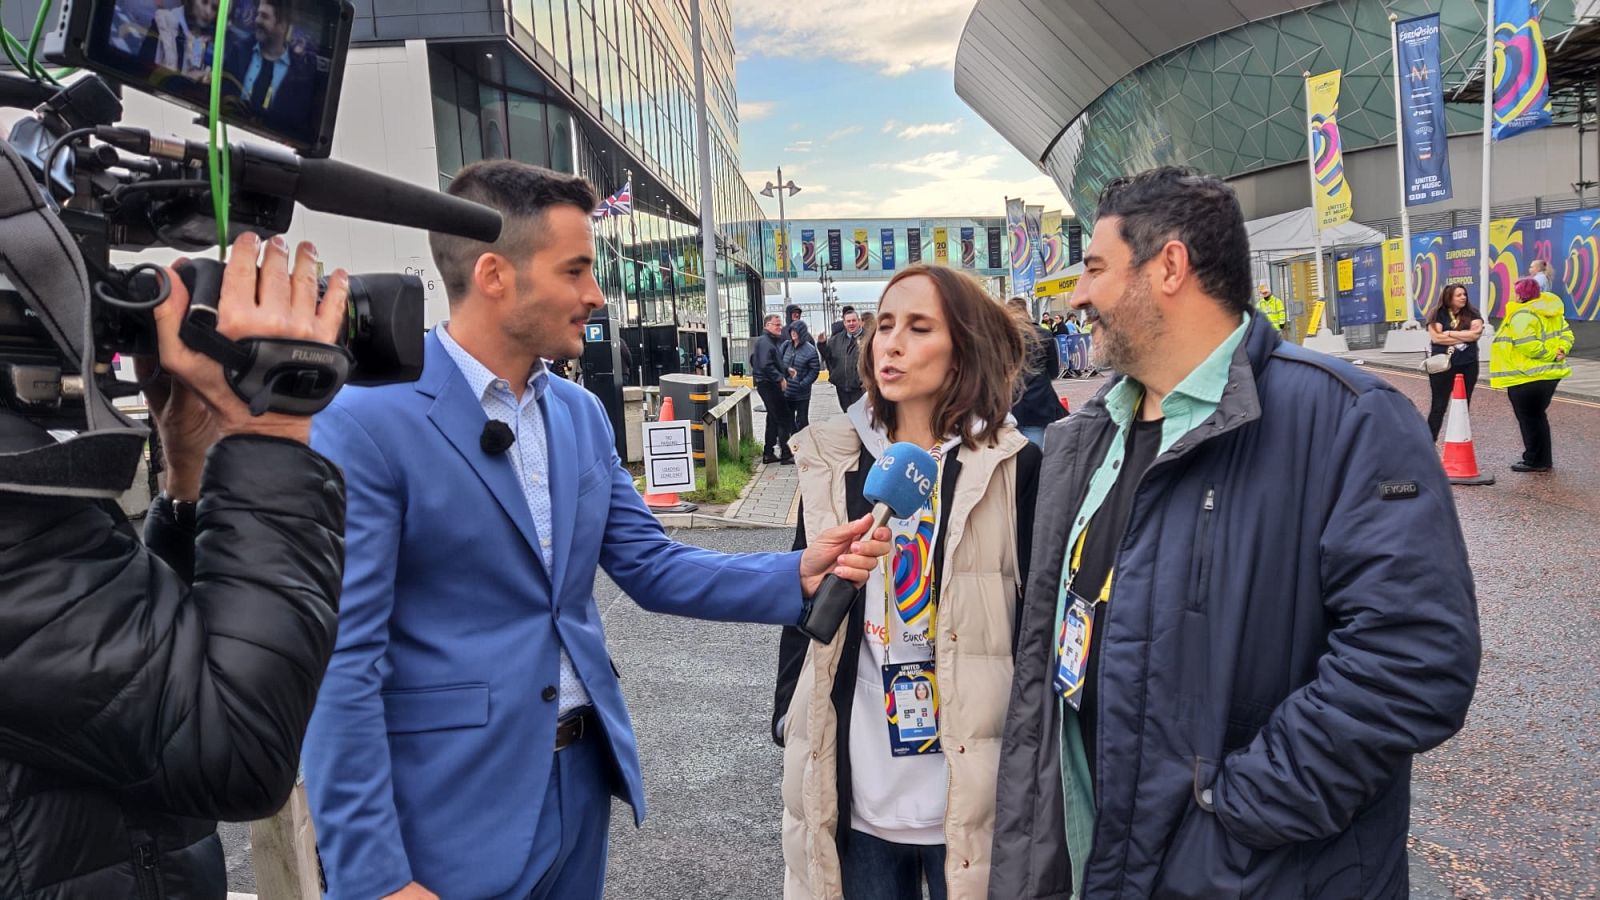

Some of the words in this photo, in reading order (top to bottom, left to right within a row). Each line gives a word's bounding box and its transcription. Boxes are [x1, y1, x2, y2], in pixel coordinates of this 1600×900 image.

[1400, 25, 1438, 41] Eurovision
[1416, 176, 1438, 184] UNITED
[1422, 180, 1442, 190] MUSIC
[1446, 248, 1476, 260] EUROVISION
[1058, 278, 1078, 289] HOSPIT
[590, 326, 600, 338] P
[292, 350, 334, 362] FUJINON
[905, 462, 930, 496] tve
[1385, 484, 1416, 494] FYORD
[864, 620, 887, 640] tve
